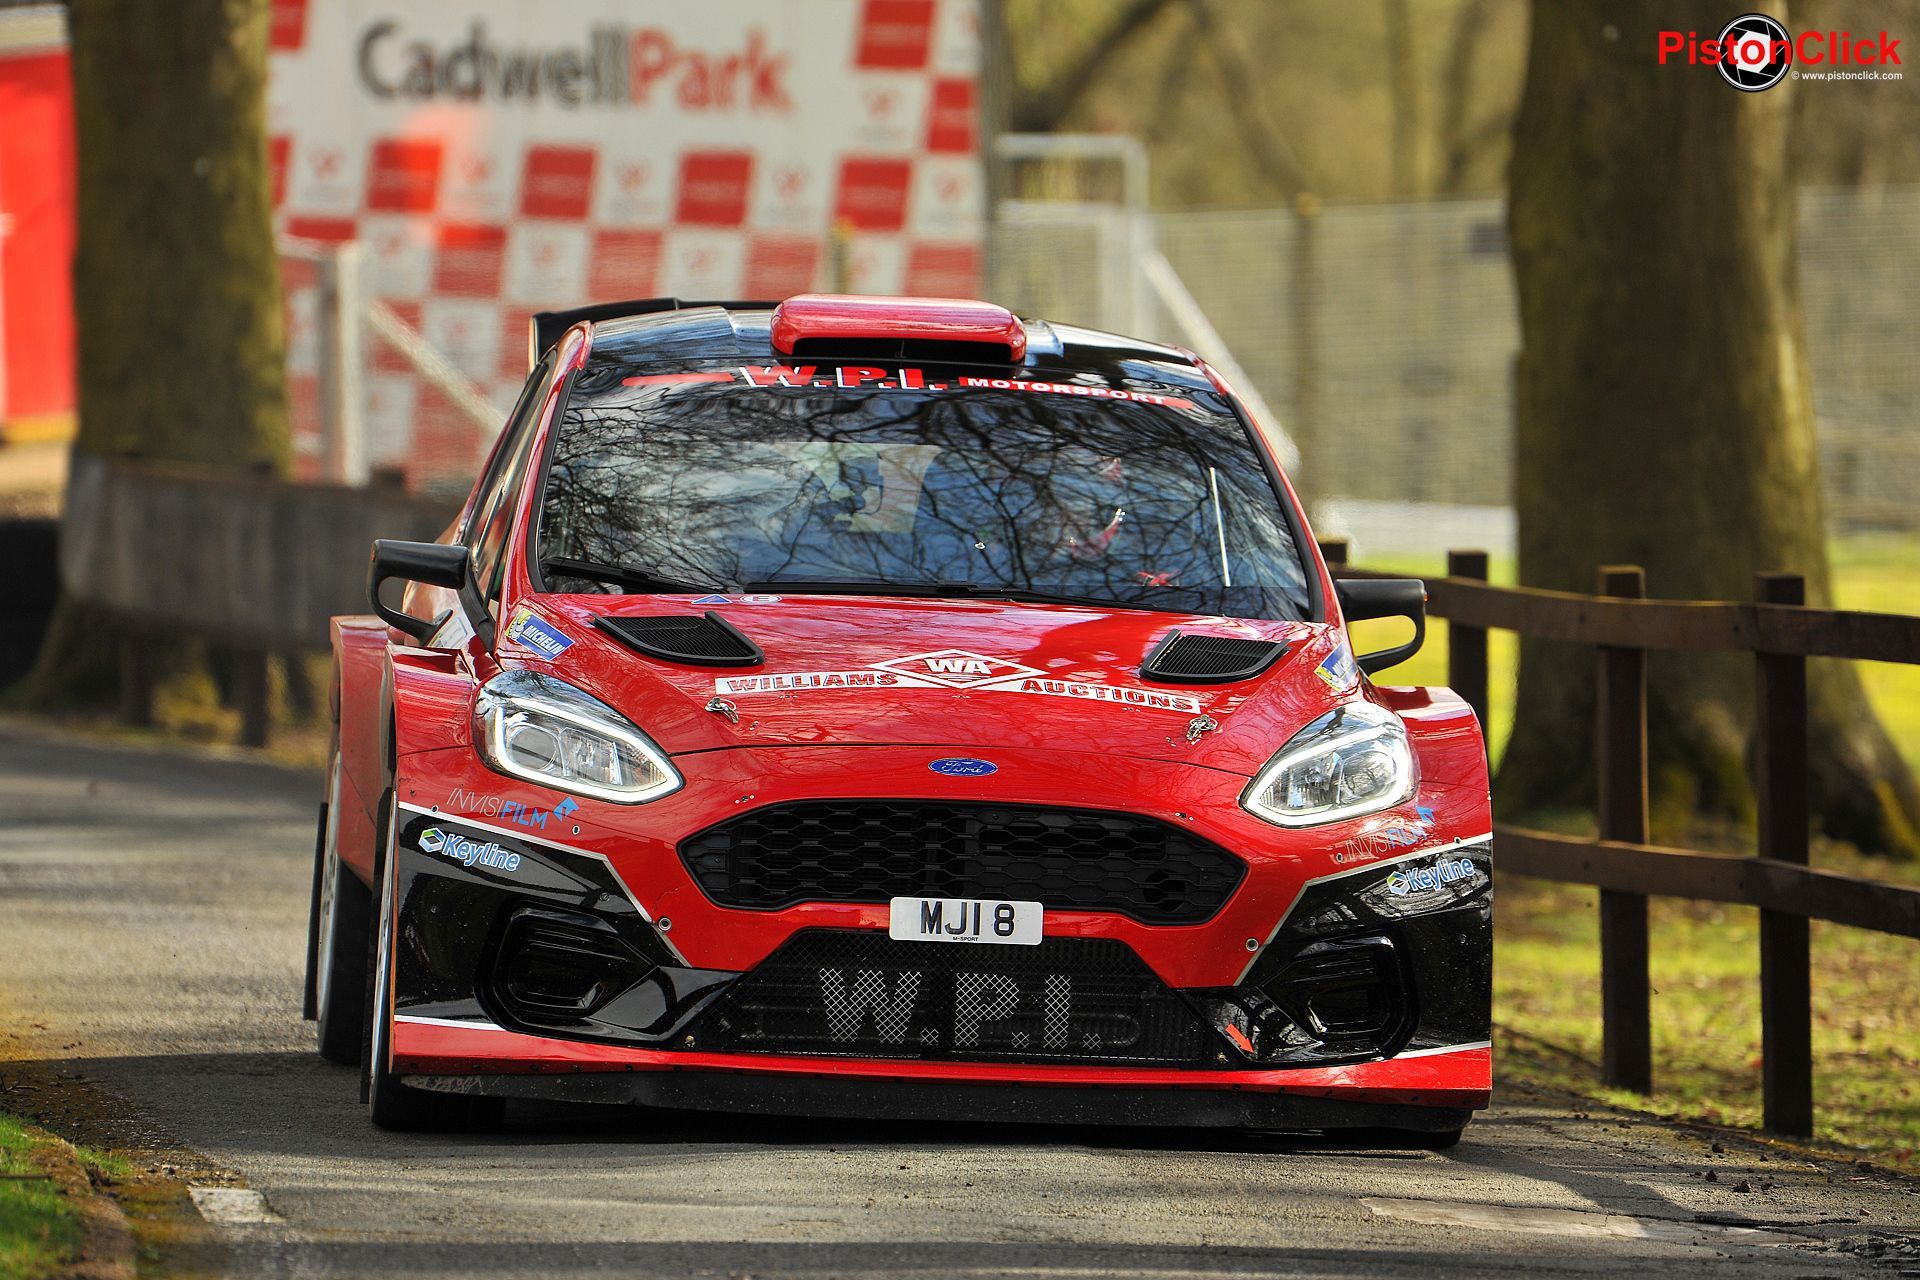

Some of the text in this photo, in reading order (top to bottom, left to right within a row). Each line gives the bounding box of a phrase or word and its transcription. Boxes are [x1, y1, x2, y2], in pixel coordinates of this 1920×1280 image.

[357, 19, 796, 110] CadwellPark
[739, 366, 1168, 405] W.P.I. MOTORSPORT
[522, 625, 566, 656] MICHELIN
[923, 658, 993, 675] WA
[726, 673, 1194, 711] WILLIAMS AUCTIONS
[939, 759, 986, 775] Ford
[446, 788, 550, 830] INVISIFILM
[442, 833, 521, 872] Keyline
[1406, 858, 1476, 891] Keyline
[993, 903, 1016, 937] 8
[818, 967, 1102, 1051] W.P.I.
